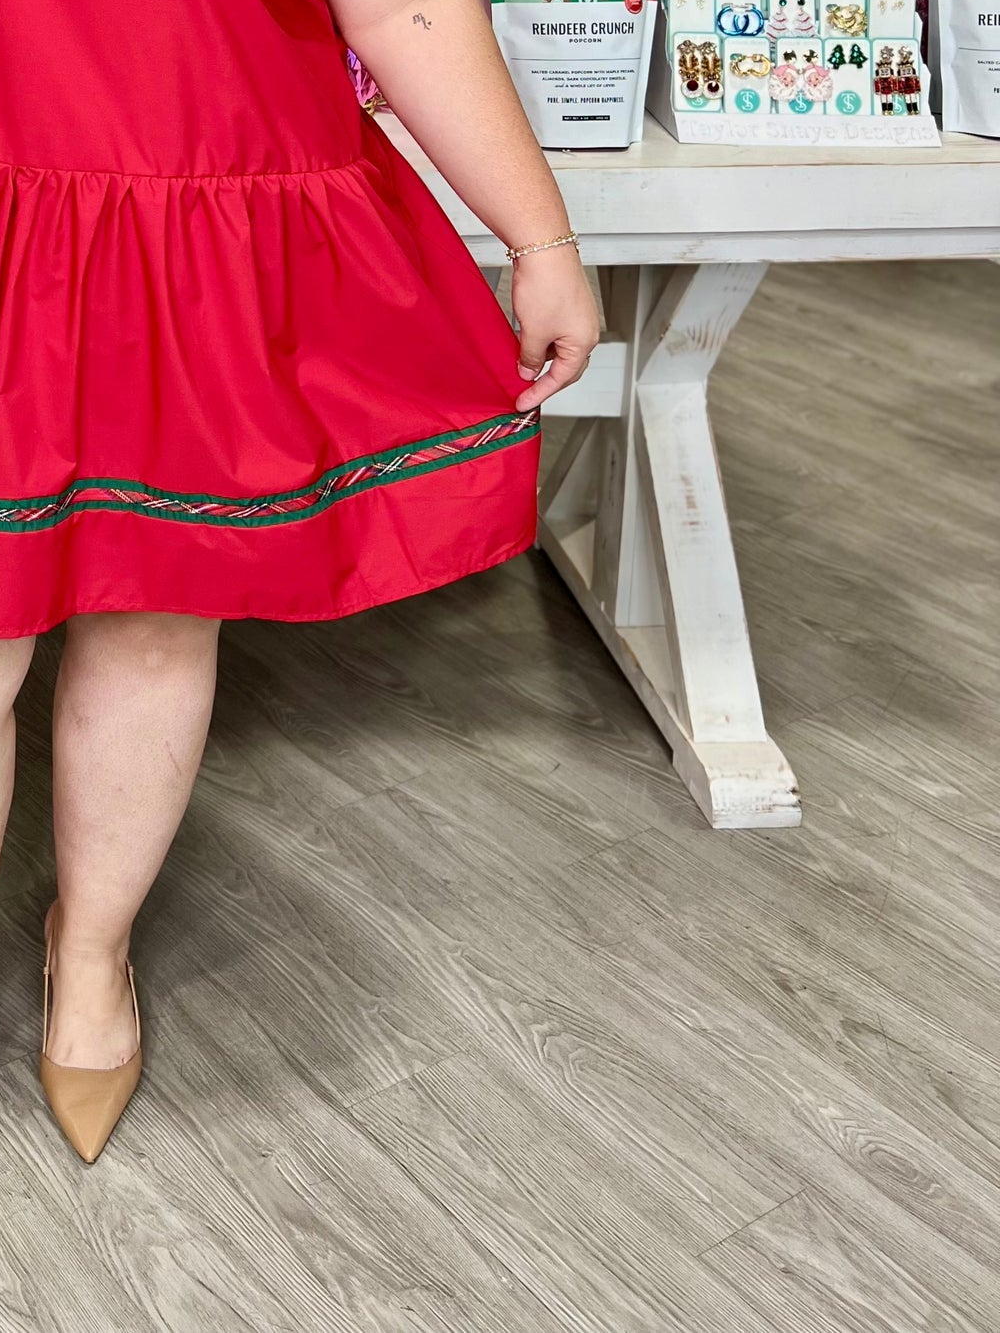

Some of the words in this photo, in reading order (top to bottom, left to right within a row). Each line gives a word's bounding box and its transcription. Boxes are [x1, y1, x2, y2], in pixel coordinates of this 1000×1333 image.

[532, 22, 587, 35] REINDEER
[591, 22, 634, 35] CRUNCH
[680, 119, 762, 139] Taylor
